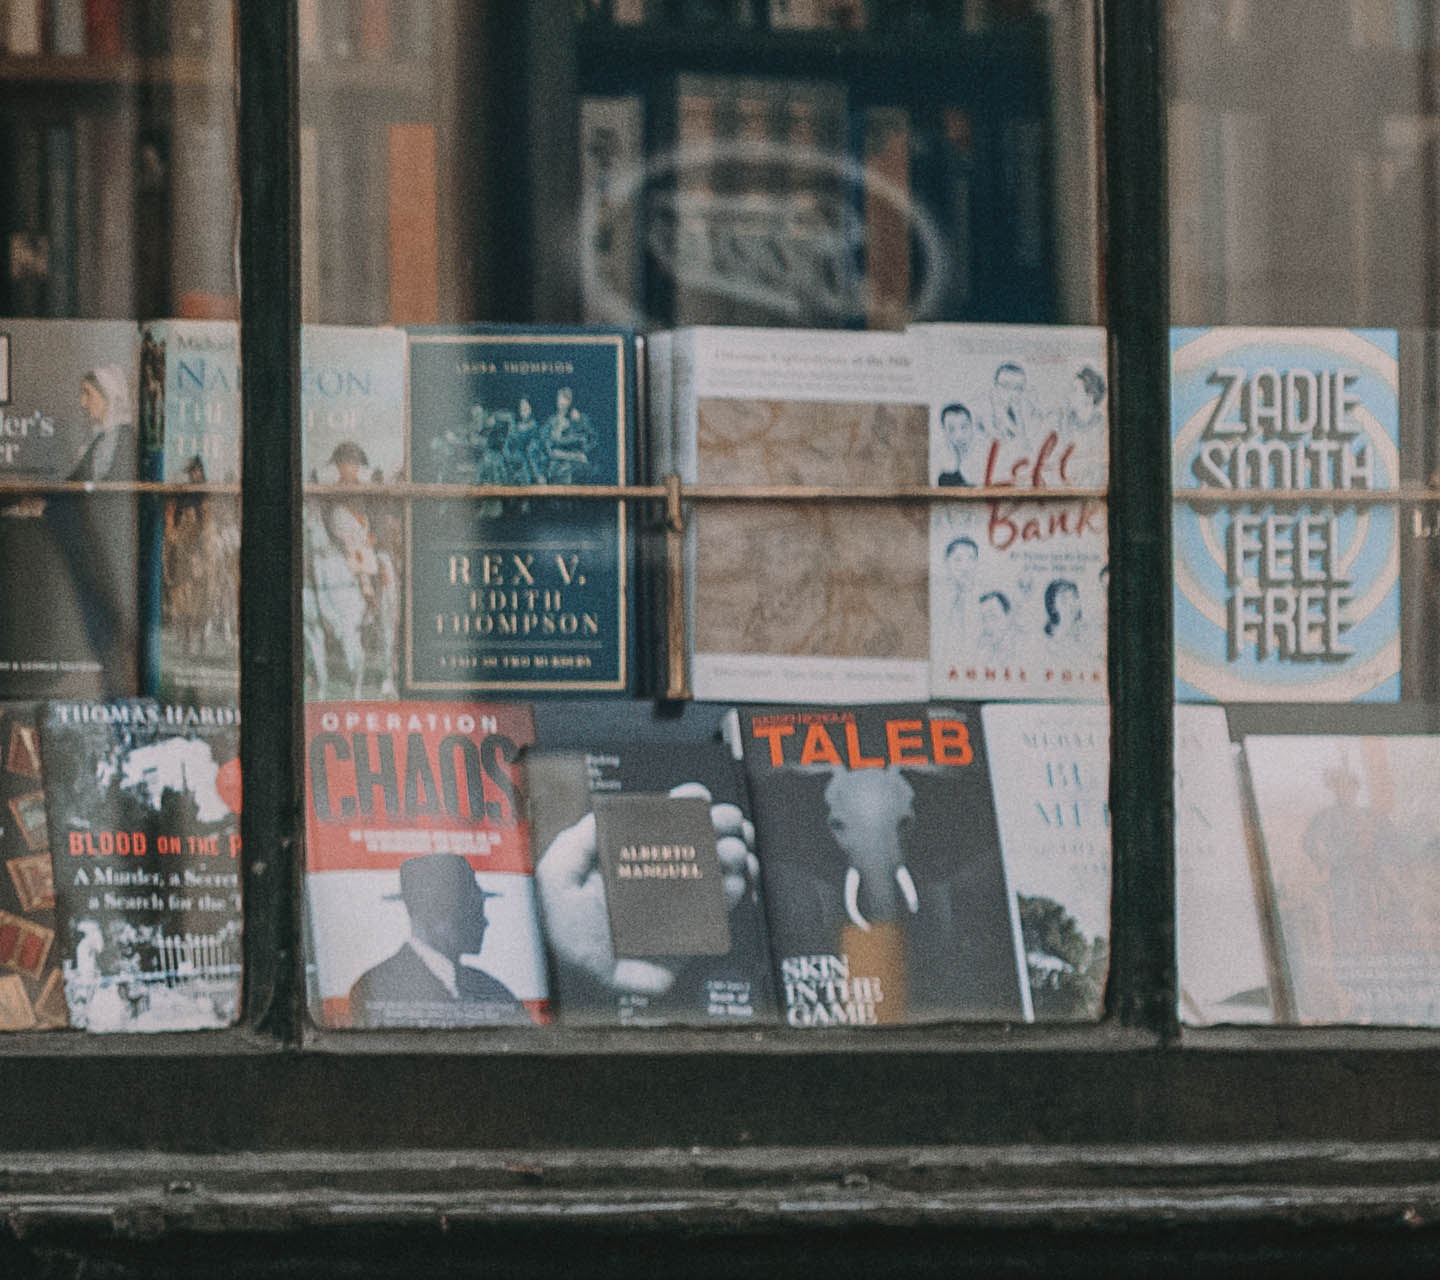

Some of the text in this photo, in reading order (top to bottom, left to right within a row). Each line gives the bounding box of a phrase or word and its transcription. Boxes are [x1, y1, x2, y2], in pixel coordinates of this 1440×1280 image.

[1209, 366, 1363, 437] ZADIE
[1195, 438, 1374, 490] SMITH
[1229, 512, 1356, 586] FEEL
[448, 553, 536, 586] REX
[469, 589, 563, 612] EDITH
[435, 612, 599, 635] THOMPSON
[1229, 586, 1356, 659] FREE
[54, 704, 159, 725] THOMAS
[320, 712, 498, 735] OPERATION
[752, 719, 975, 770] TALEB
[308, 732, 521, 829] CHAOS
[68, 831, 147, 857] BLOOD
[157, 836, 181, 854] ON
[187, 835, 218, 856] THE
[73, 868, 90, 886] A
